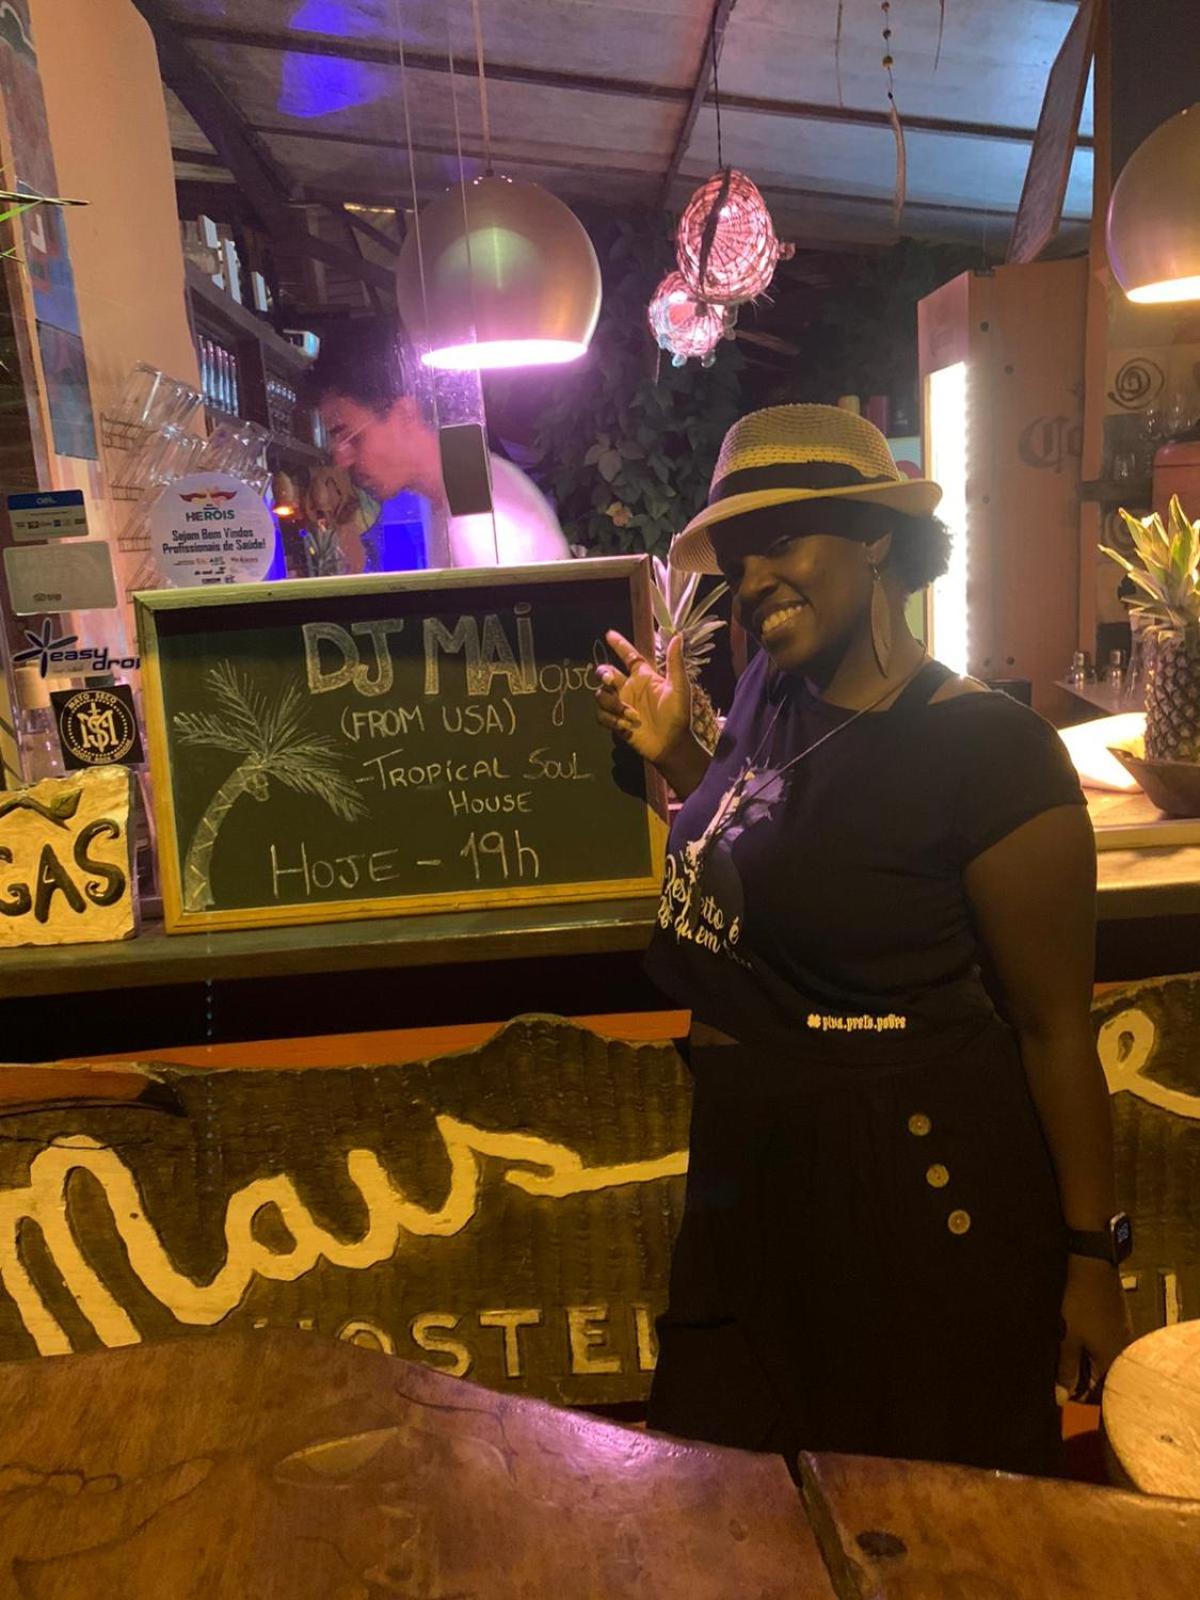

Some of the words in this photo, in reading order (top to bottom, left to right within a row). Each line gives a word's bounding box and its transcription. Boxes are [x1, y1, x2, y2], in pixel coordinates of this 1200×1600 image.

[162, 542, 220, 554] Profissionais
[223, 541, 234, 551] de
[172, 529, 199, 543] Sejam
[201, 528, 221, 540] Bem
[223, 526, 254, 538] Vindos
[50, 647, 108, 662] easy
[302, 618, 405, 697] DJ
[340, 705, 425, 743] (FROM
[442, 698, 516, 735] USA)
[460, 829, 540, 880] 19h
